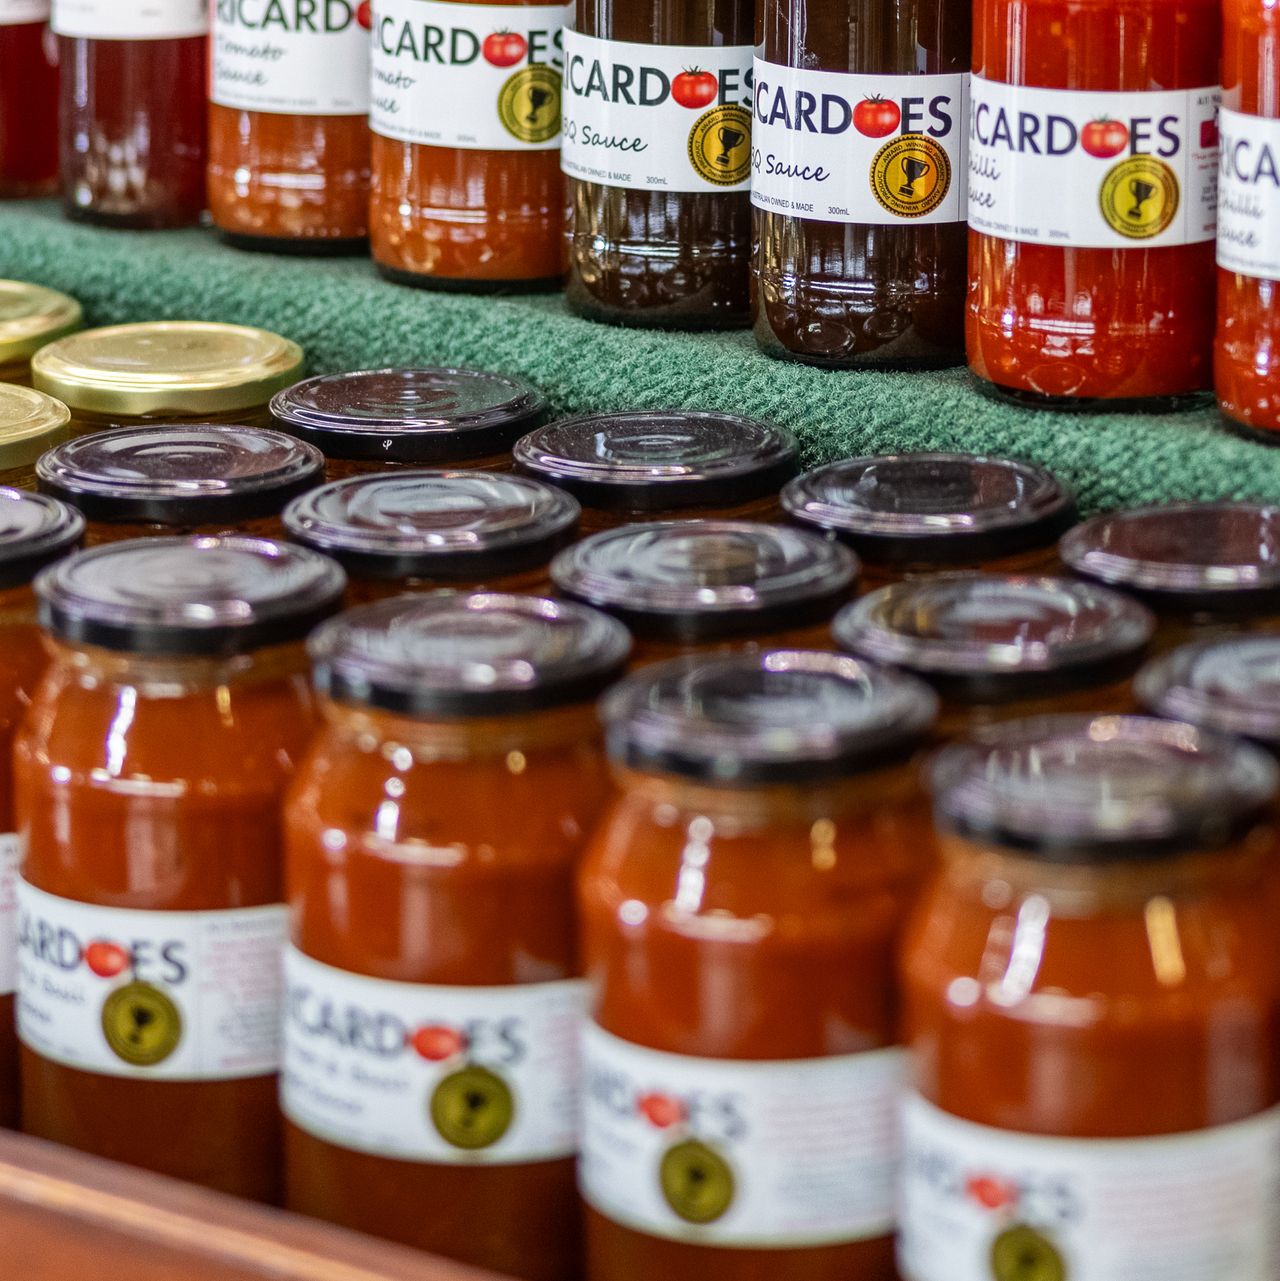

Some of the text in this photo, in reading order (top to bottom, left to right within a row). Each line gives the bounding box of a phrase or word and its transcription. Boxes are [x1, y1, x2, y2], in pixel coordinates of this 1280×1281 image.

[374, 69, 417, 90] mato
[581, 124, 649, 153] Sauce
[882, 144, 903, 163] AWARD
[905, 141, 934, 154] WINNING
[765, 153, 831, 182] Sauce
[613, 171, 632, 183] MADE
[645, 175, 669, 186] 300mL
[770, 196, 790, 209] OWNED
[791, 201, 795, 210] &
[796, 202, 814, 213] MADE
[827, 206, 850, 216] 300mL
